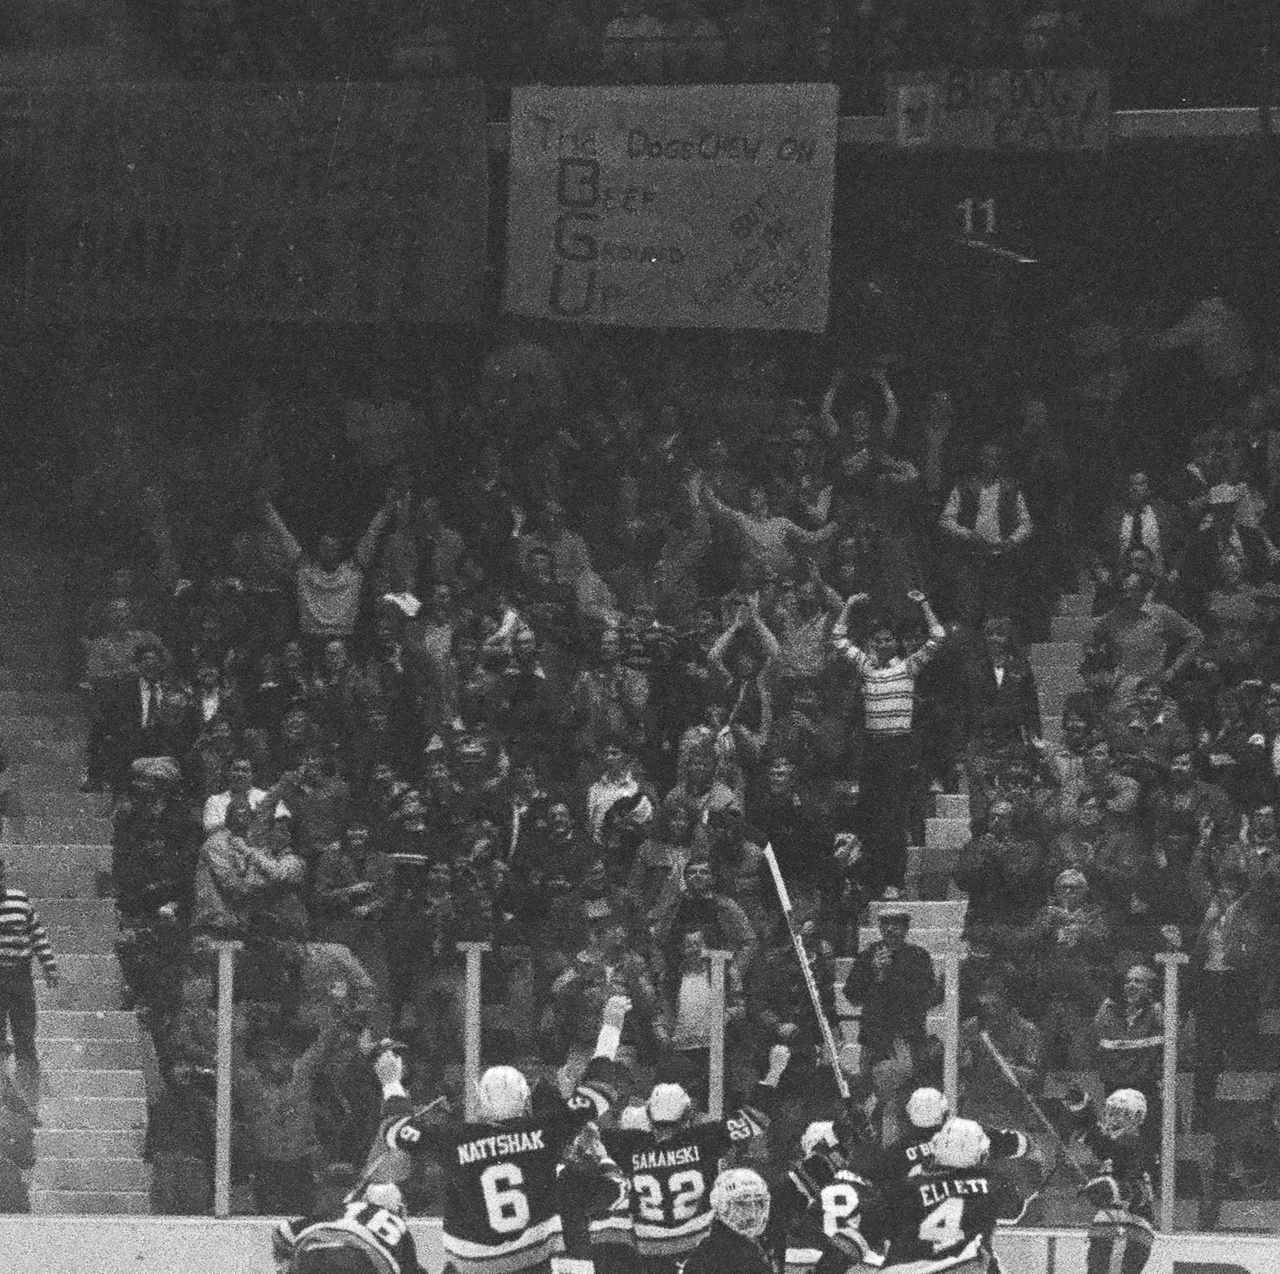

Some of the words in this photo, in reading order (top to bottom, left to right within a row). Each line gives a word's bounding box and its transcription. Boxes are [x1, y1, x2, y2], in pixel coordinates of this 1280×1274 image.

[956, 196, 997, 235] 11
[457, 1129, 545, 1165] NATYSHAK
[631, 1145, 701, 1171] SAMANSKI
[479, 1162, 531, 1233] 6
[632, 1169, 705, 1221] 22
[919, 1178, 989, 1207] ELLETT
[917, 1197, 966, 1254] 4
